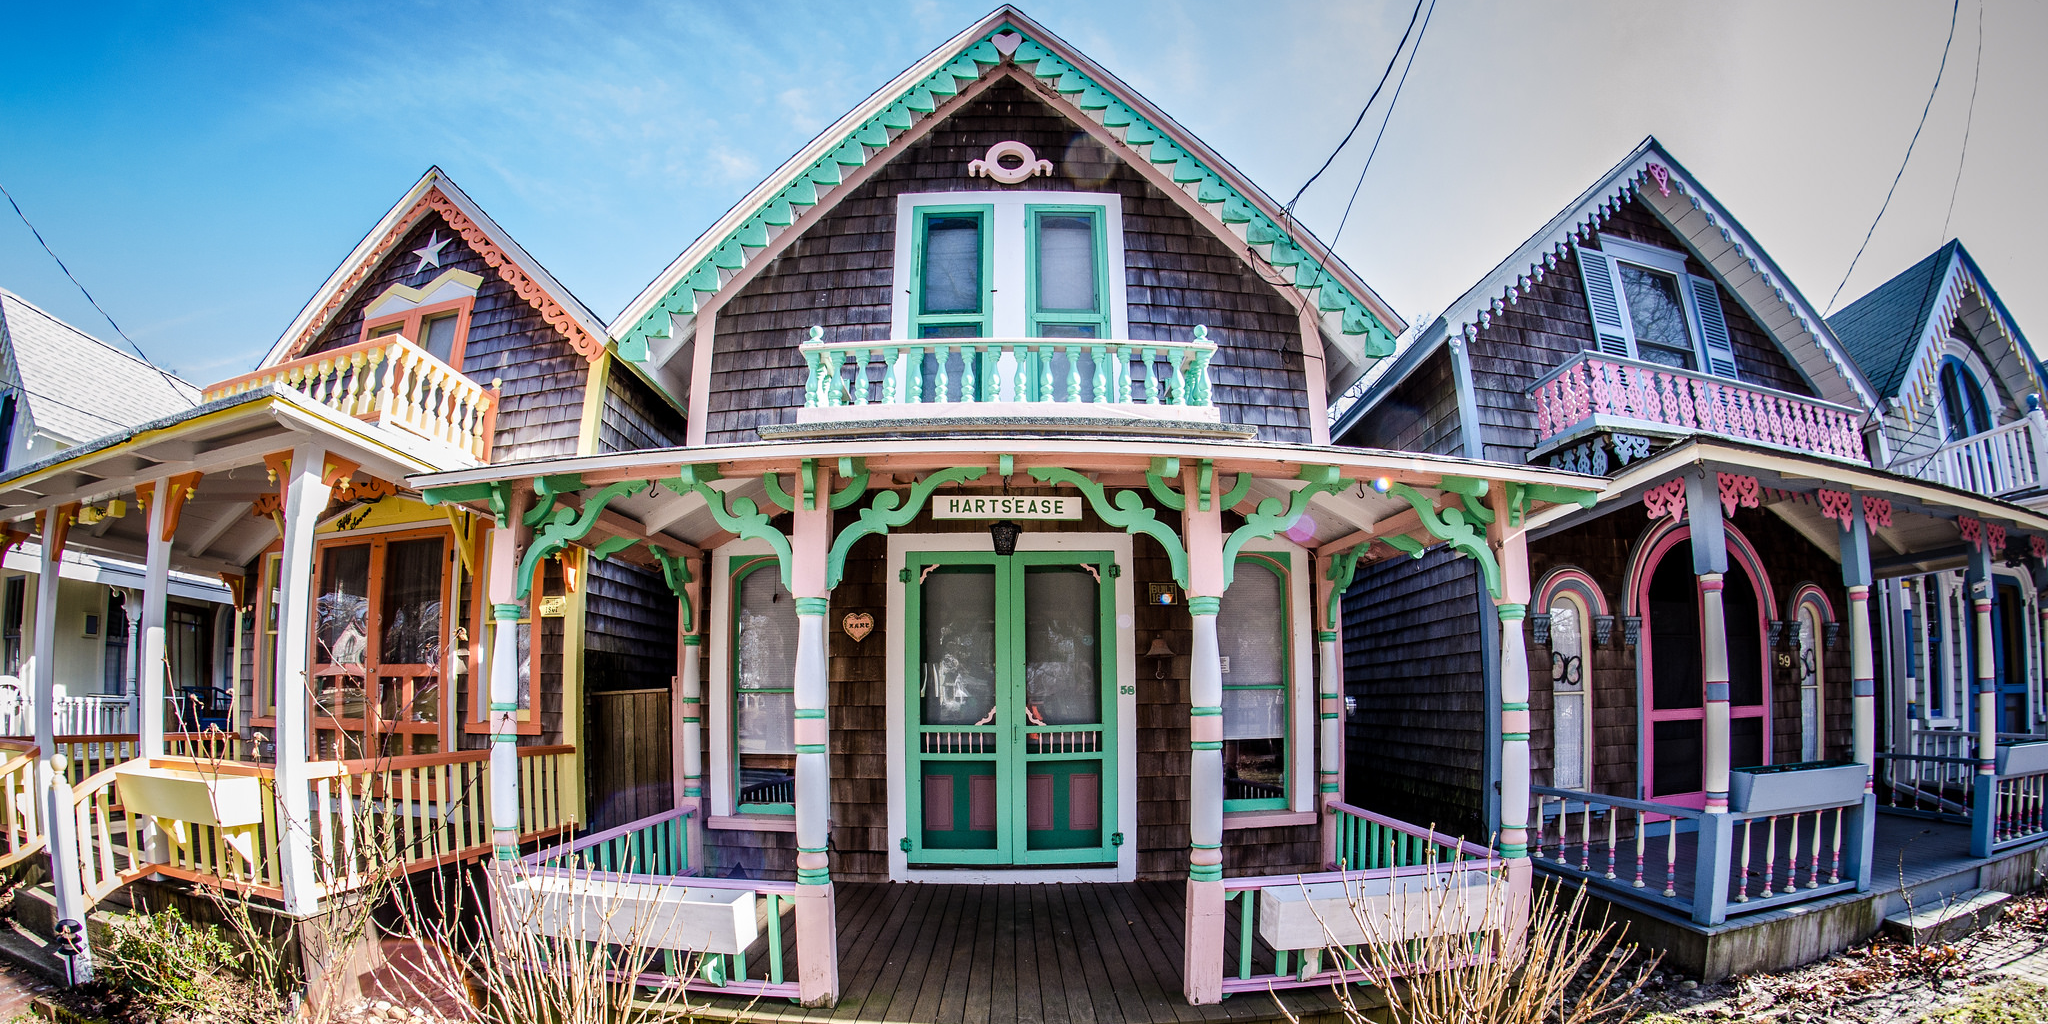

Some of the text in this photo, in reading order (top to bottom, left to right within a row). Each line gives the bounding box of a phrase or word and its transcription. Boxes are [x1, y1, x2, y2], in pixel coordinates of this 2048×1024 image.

[1151, 584, 1175, 594] BUILT
[1152, 593, 1175, 603] 187
[1778, 653, 1791, 668] 59
[1120, 685, 1135, 696] 58
